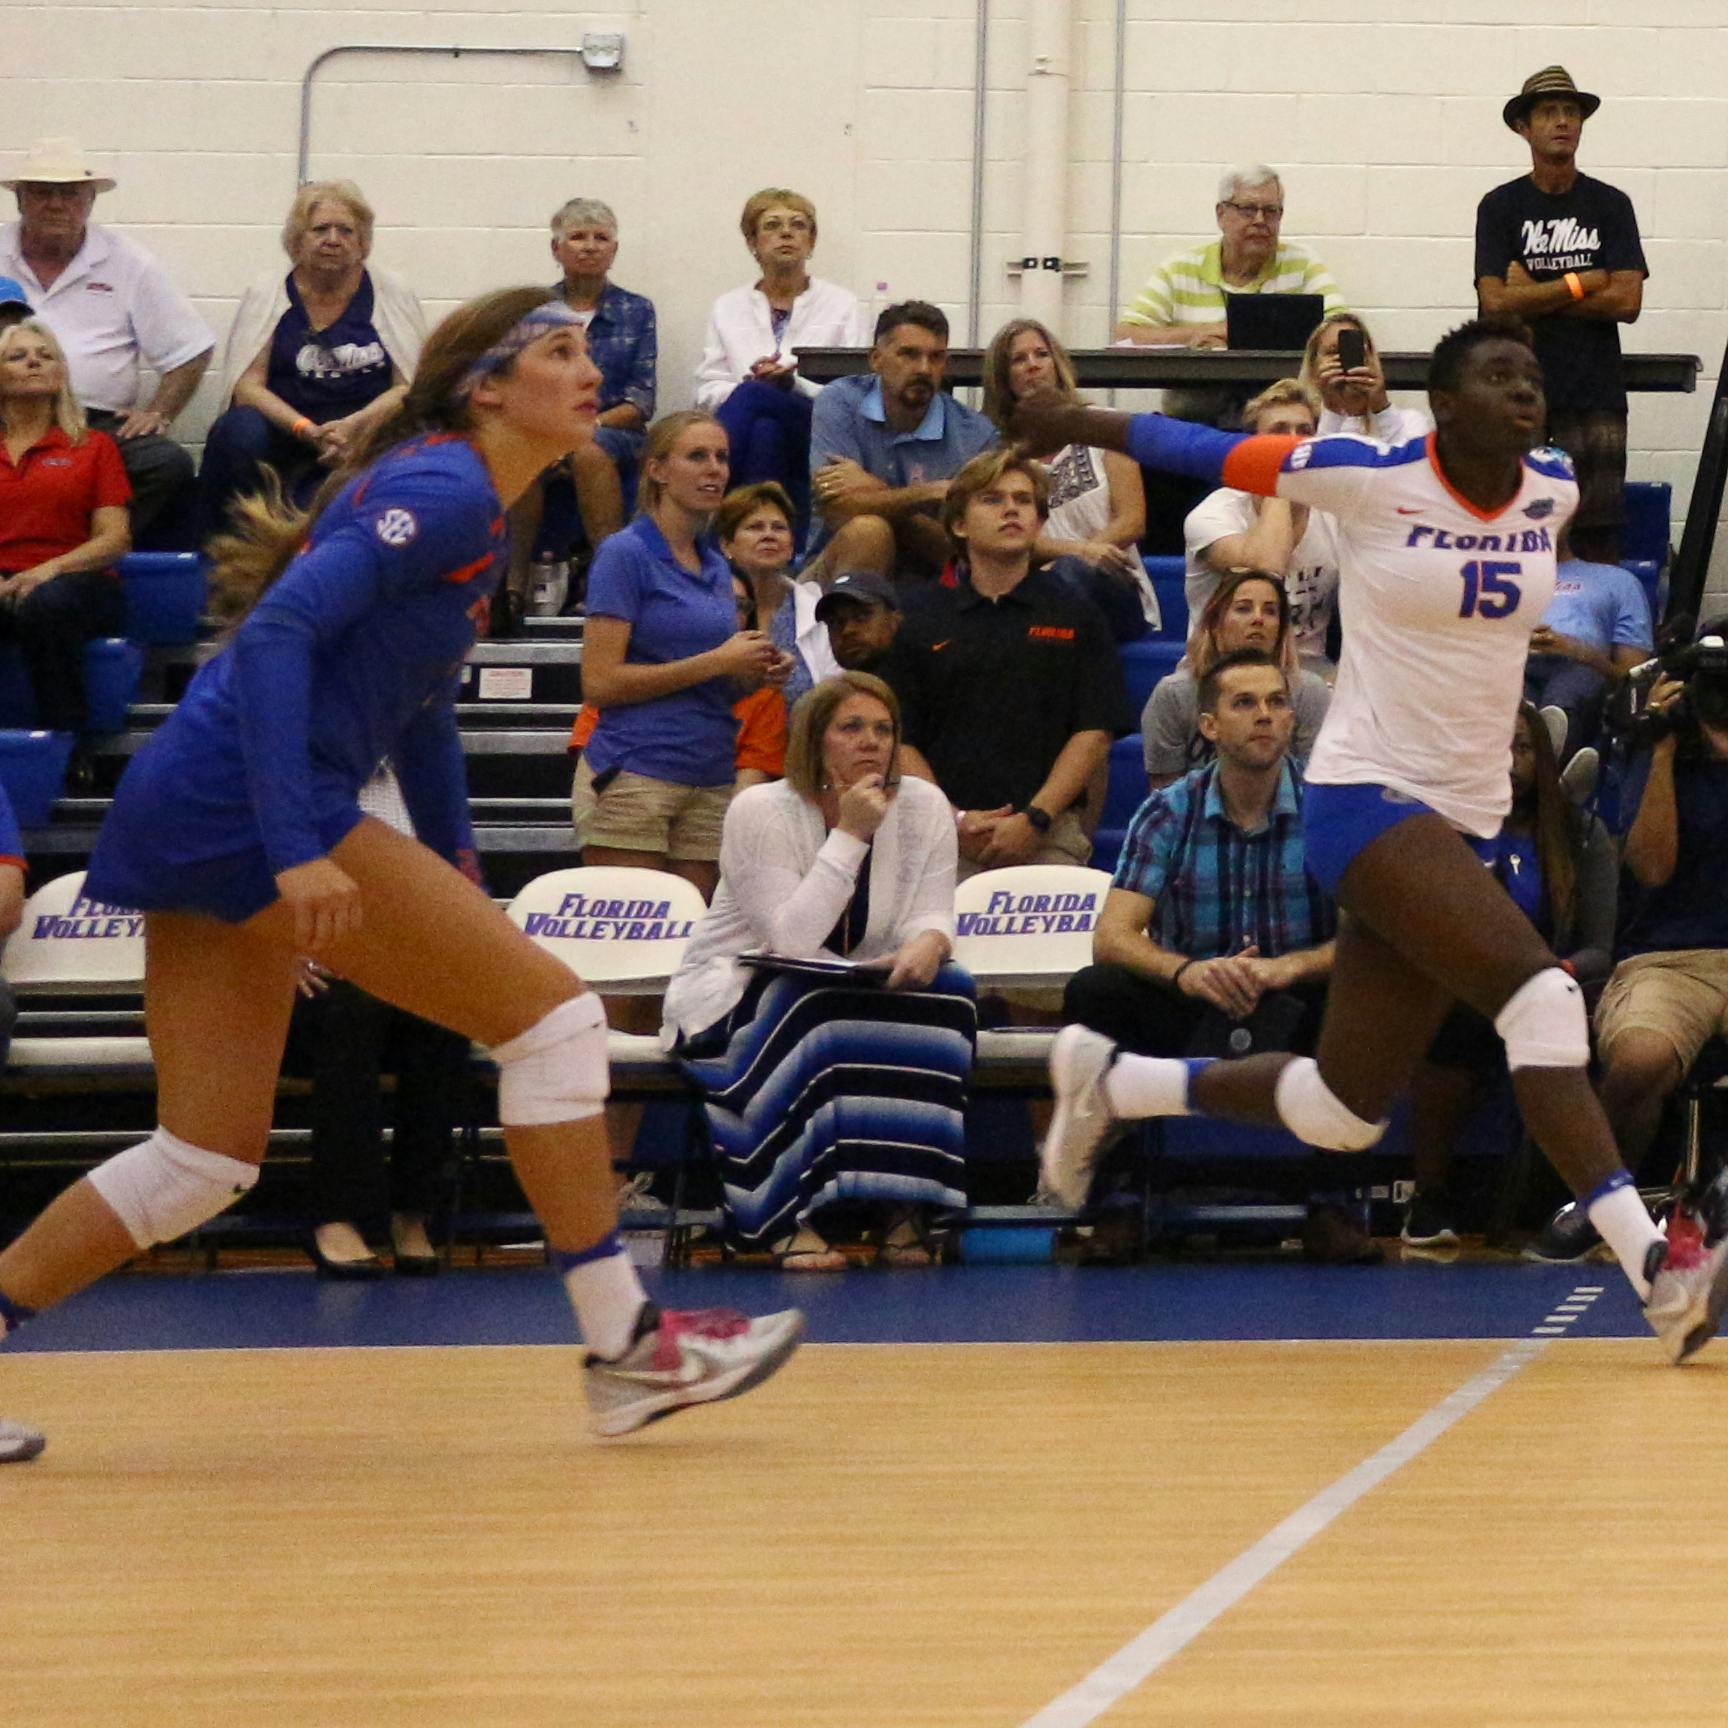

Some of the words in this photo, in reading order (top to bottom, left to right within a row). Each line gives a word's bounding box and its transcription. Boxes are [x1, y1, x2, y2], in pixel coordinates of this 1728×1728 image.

[1547, 216, 1601, 253] Miss
[1526, 253, 1594, 271] VOLLEYBALL
[1458, 559, 1523, 619] 15
[557, 893, 671, 919] FLORIDA
[986, 891, 1097, 915] FLORIDA
[32, 915, 145, 940] VOLLEY
[524, 913, 696, 940] VOLLEYBALL
[956, 913, 1097, 936] VOLLEYBA
